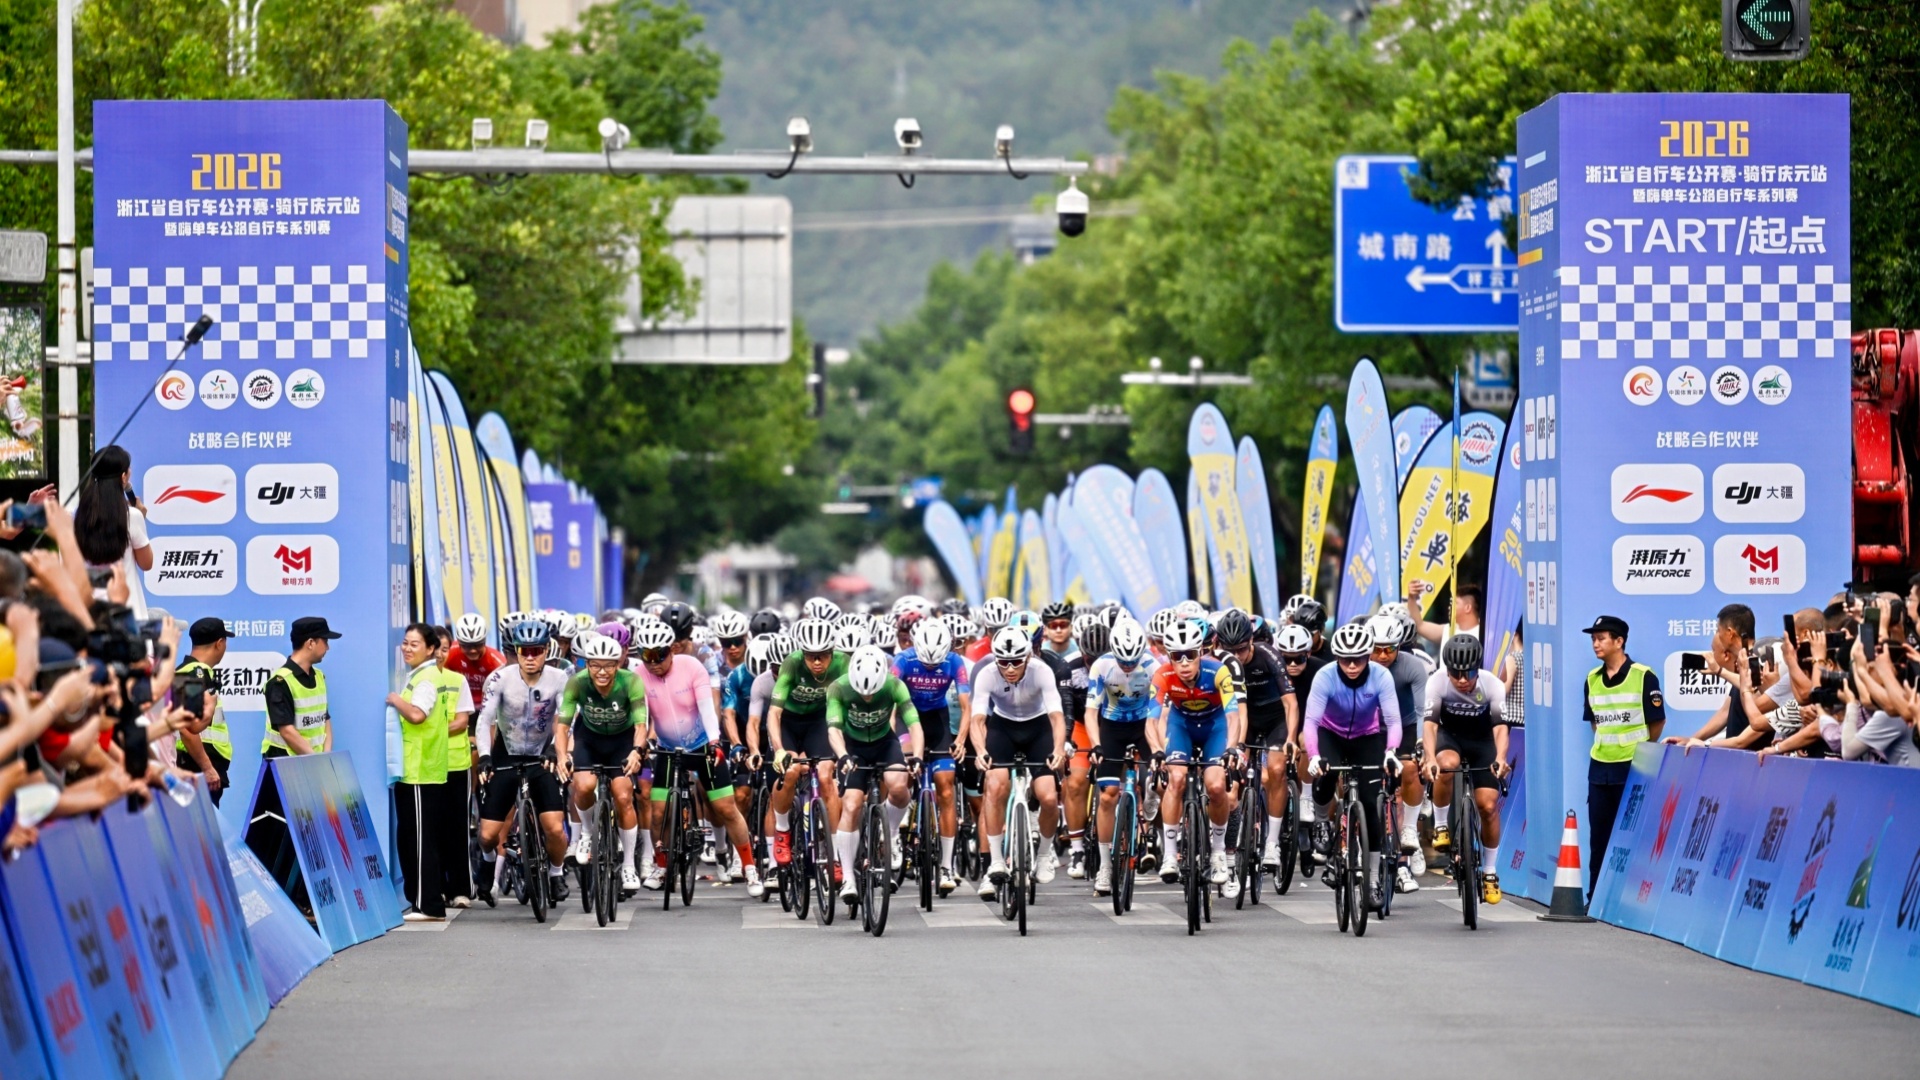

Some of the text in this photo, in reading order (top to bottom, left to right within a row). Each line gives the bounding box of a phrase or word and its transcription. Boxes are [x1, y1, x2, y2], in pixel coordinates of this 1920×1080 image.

[1660, 121, 1749, 158] 2026
[191, 153, 282, 191] 2026
[1585, 165, 1828, 184] 浙江省自行车公开赛·骑行庆元站
[1632, 188, 1798, 204] 暨嗨单车公路自行车系列赛
[116, 197, 361, 218] 浙江省自行车公开赛·骑行庆元站
[164, 219, 331, 237] 暨嗨单车公路自行车系列赛
[1358, 232, 1453, 261] 城南路
[188, 431, 292, 449] 战略合作伙伴
[1656, 431, 1759, 449] 战略合作伙伴
[299, 485, 327, 500] 大疆
[1766, 485, 1794, 500] 大疆
[161, 549, 219, 567] 湃原力
[1629, 548, 1687, 566] 湃原力
[158, 569, 224, 583] PAIXFORCE
[281, 577, 313, 586] 黎明方周
[1626, 569, 1692, 582] PAIXFORCE
[1749, 577, 1780, 586] 黎明方周
[222, 619, 285, 637] 定供应商
[1667, 619, 1717, 637] 指定供
[215, 687, 265, 696] HAPETIM
